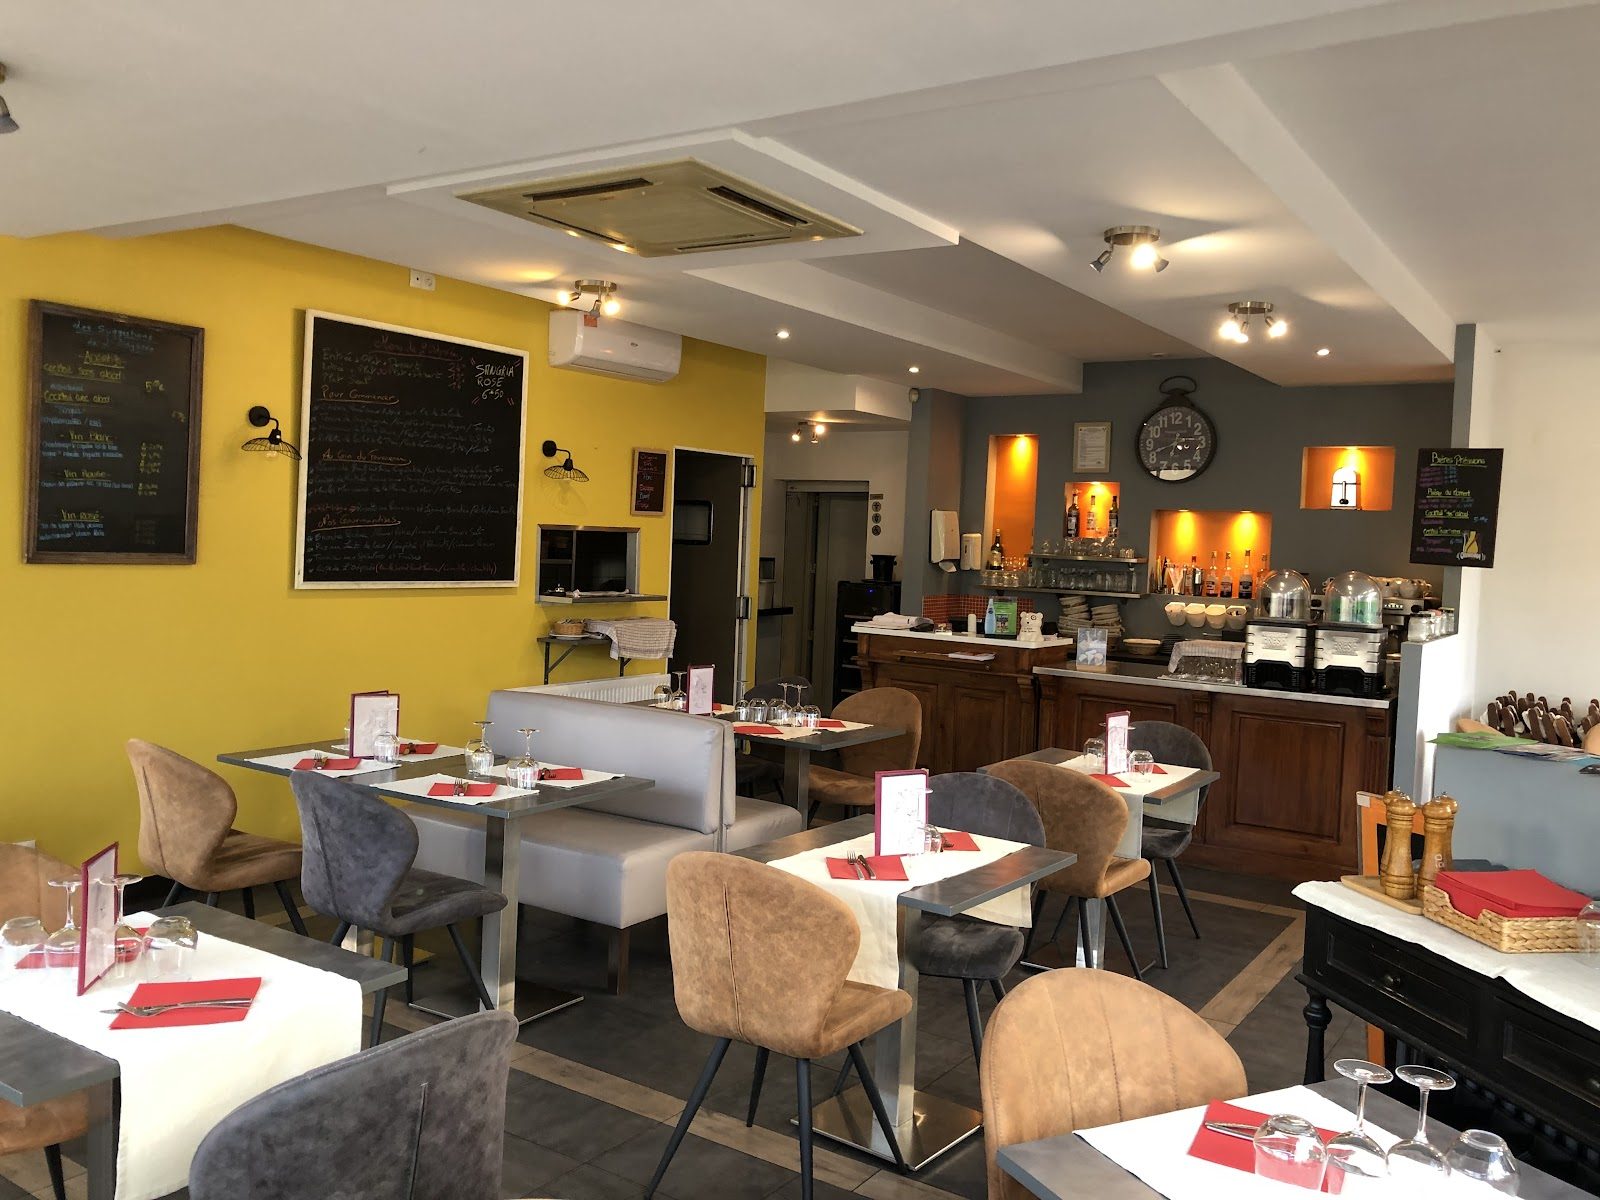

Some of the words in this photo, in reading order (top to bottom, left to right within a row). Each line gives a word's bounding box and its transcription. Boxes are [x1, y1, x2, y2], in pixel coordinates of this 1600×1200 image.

[475, 364, 514, 378] SANGRIA
[477, 376, 505, 387] ROSE
[321, 385, 344, 399] Pour
[349, 389, 396, 400] Commencer
[1159, 416, 1168, 428] 11
[1170, 412, 1182, 425] 12
[1186, 415, 1192, 428] 1
[1148, 426, 1160, 438] 10
[1194, 423, 1202, 435] 2
[1146, 439, 1154, 451] 9
[1199, 436, 1206, 448] 3
[1149, 451, 1157, 464] 8
[1193, 450, 1201, 462] 4
[1159, 461, 1168, 471] 7
[1172, 462, 1179, 474] 6
[1183, 460, 1191, 471] 5
